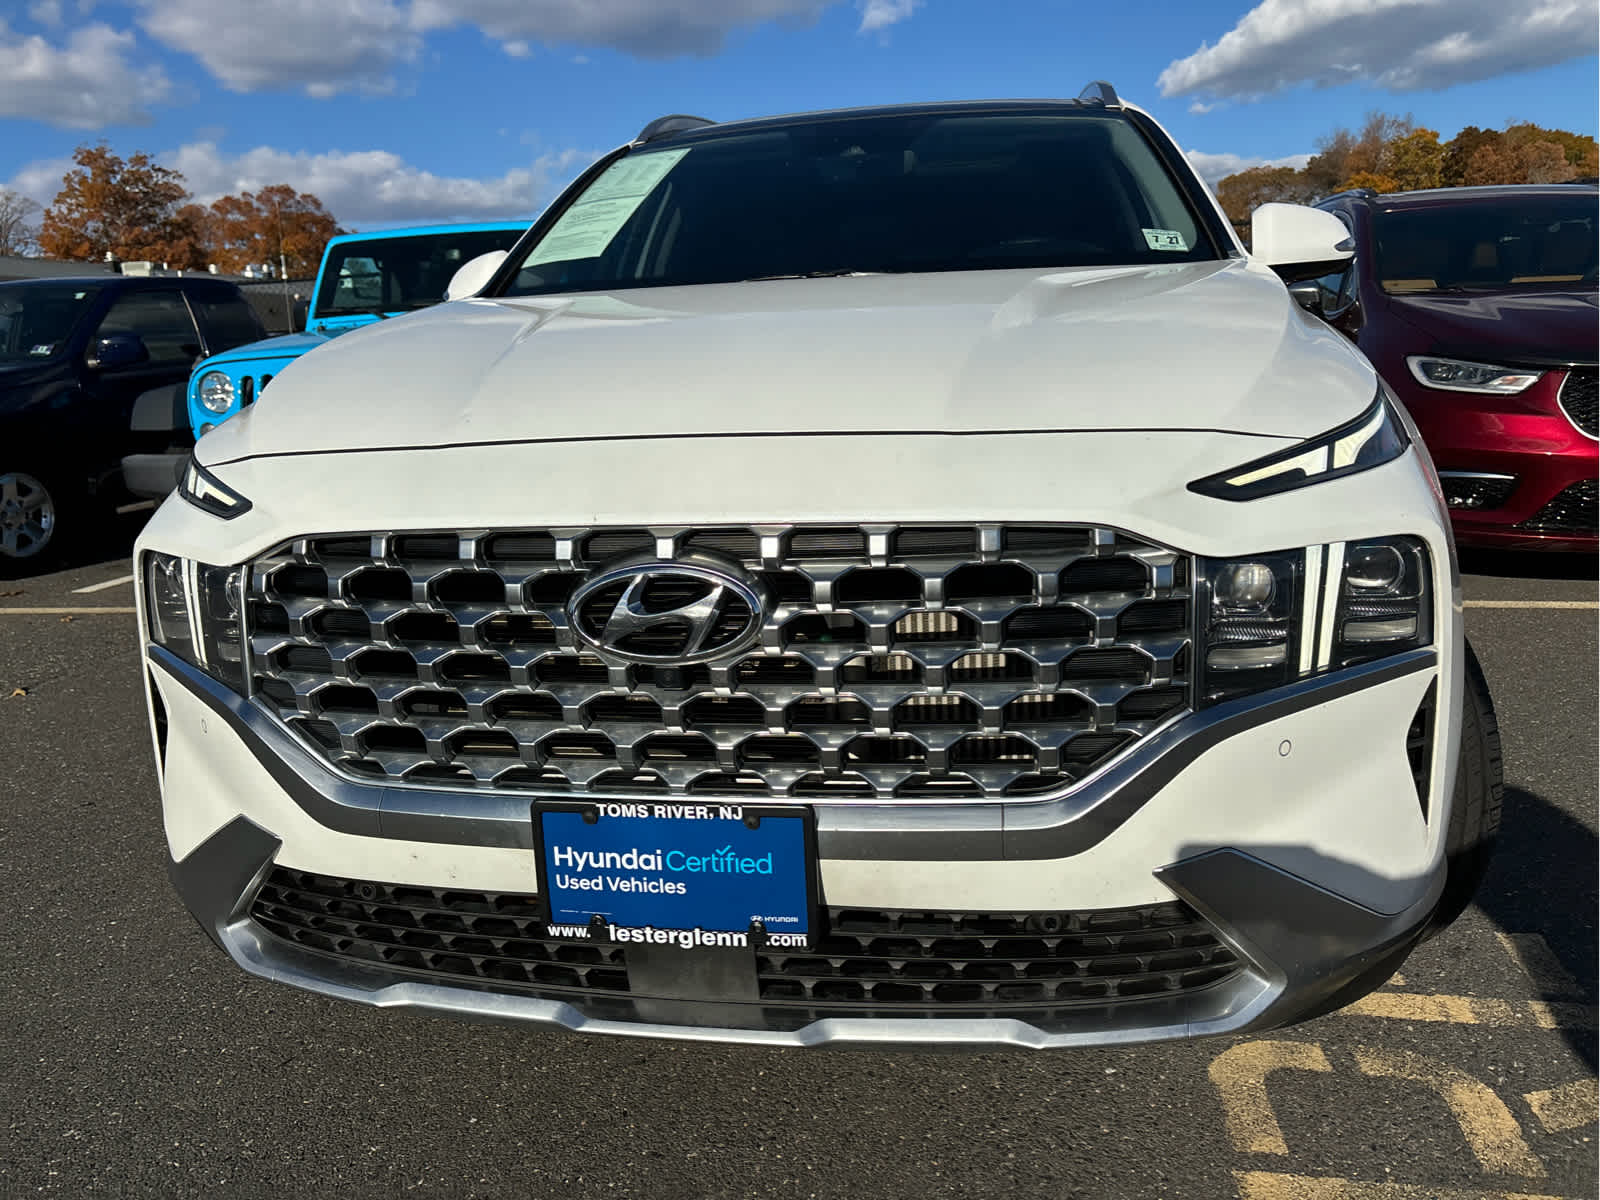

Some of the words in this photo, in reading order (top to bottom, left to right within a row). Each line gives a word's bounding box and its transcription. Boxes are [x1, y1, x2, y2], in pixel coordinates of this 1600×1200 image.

[596, 803, 649, 818] TOMS
[654, 805, 714, 820] RIVER,
[720, 806, 743, 820] NJ
[553, 846, 663, 872] Hyundai
[666, 844, 773, 875] Certified
[555, 874, 603, 891] Used
[606, 876, 687, 895] Vehicles
[547, 925, 591, 938] www.
[609, 924, 748, 949] lesterglenn
[766, 935, 808, 947] .com
